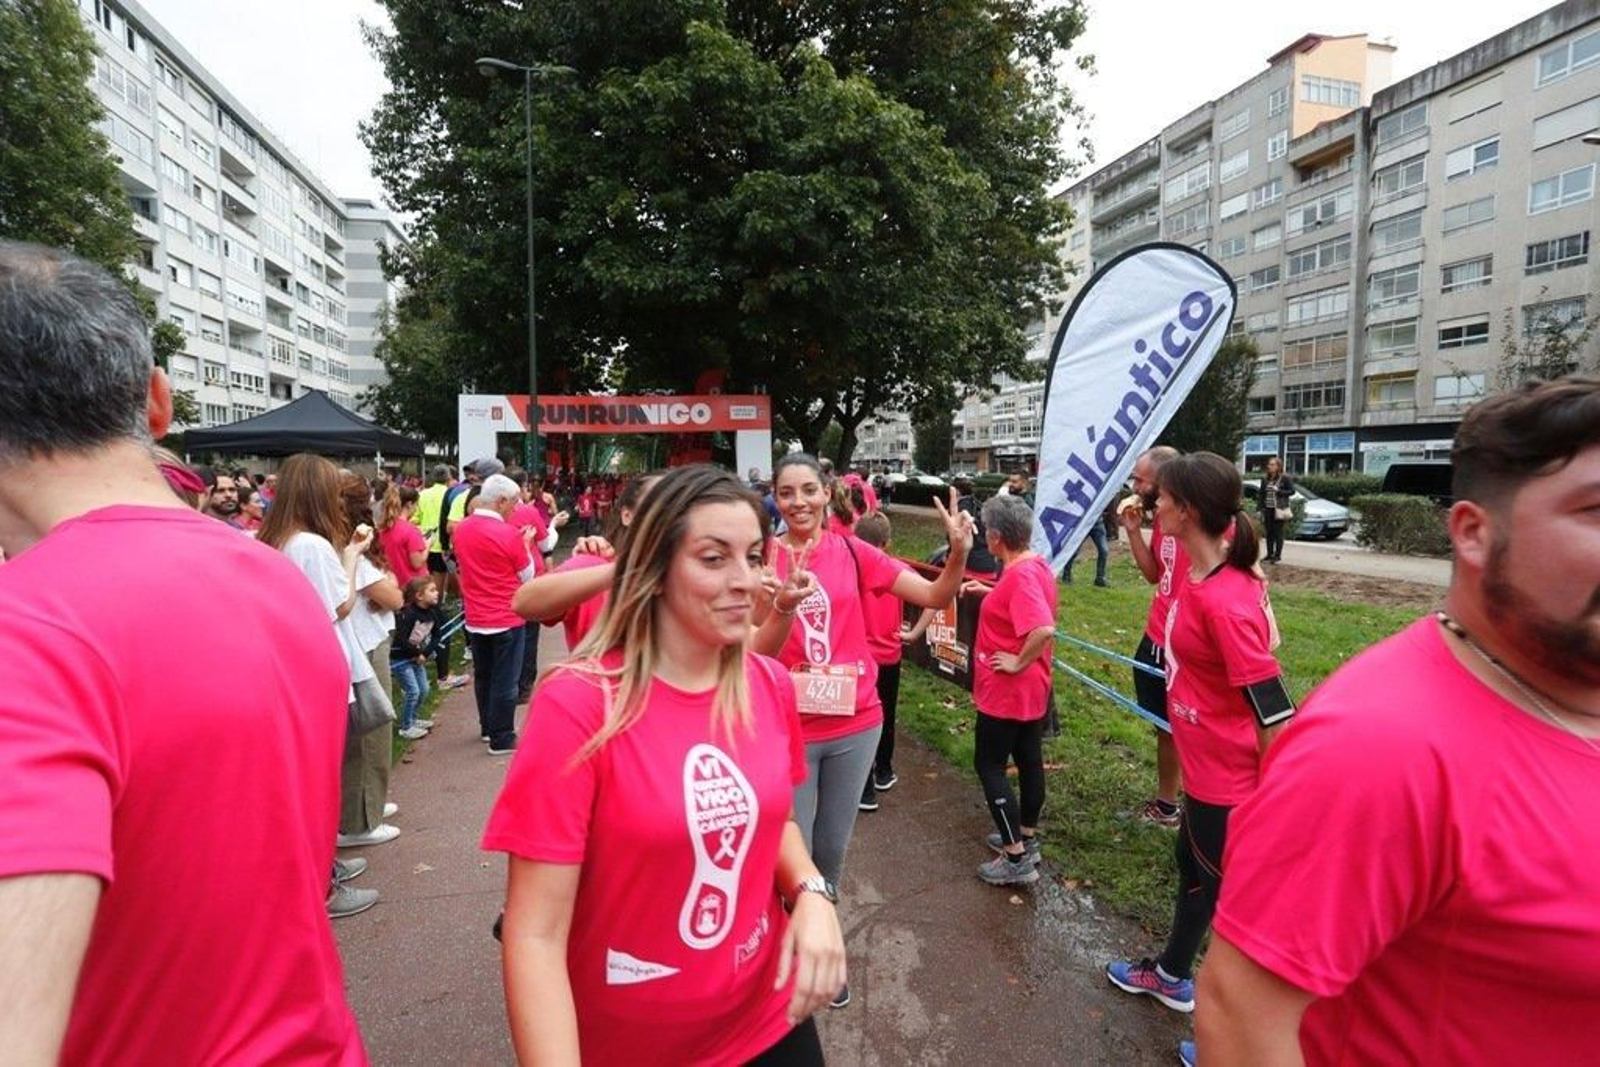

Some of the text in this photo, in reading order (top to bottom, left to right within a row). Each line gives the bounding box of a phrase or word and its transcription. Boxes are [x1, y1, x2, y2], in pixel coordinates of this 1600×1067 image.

[1038, 290, 1213, 555] Atlántico
[805, 679, 842, 701] 4241
[694, 786, 744, 812] VIGO
